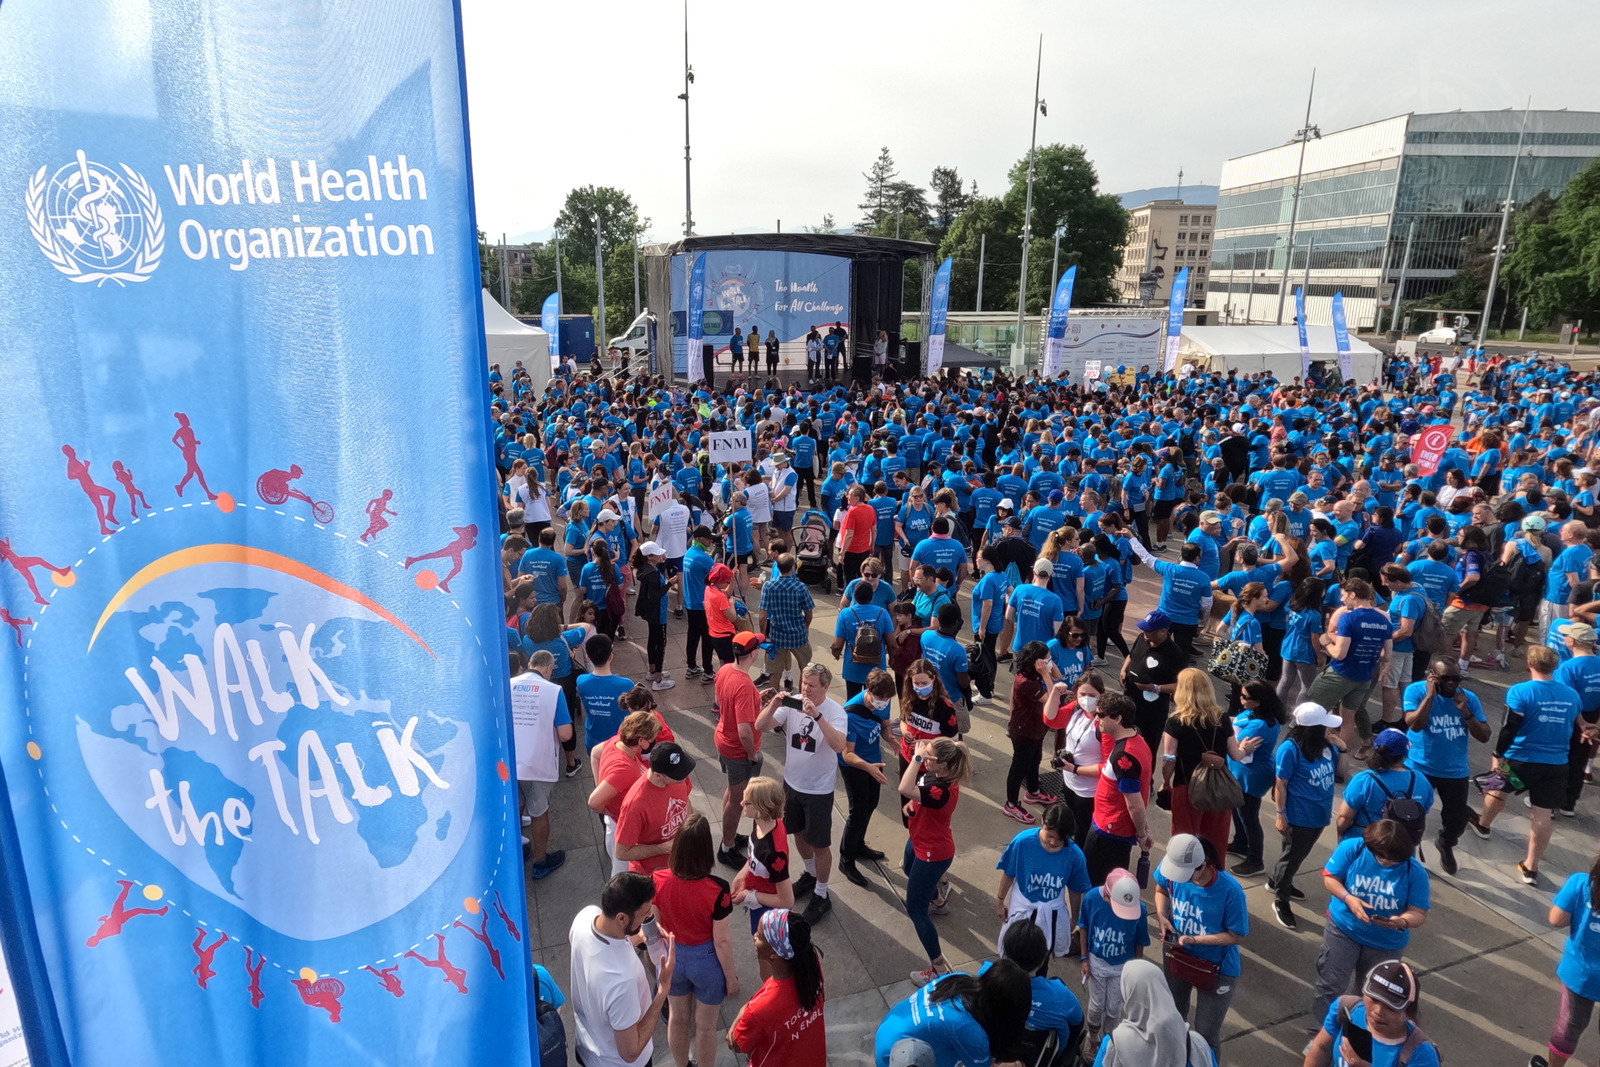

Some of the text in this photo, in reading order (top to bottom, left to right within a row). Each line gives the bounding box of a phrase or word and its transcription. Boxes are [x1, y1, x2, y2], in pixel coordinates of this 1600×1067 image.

[164, 154, 428, 206] World Health
[178, 212, 435, 271] Organization
[721, 286, 742, 299] WALK
[774, 279, 819, 294] The Health
[774, 298, 844, 316] For All Challenge
[712, 437, 748, 451] FNM
[1420, 449, 1439, 462] INFO
[650, 489, 671, 509] FNM
[123, 621, 350, 742] WALK
[512, 685, 540, 693] #ENDTB
[907, 714, 934, 732] ANADA
[1431, 714, 1462, 728] WALK
[1443, 727, 1467, 742] TALK
[1309, 761, 1334, 779] WALK
[144, 716, 451, 847] the TALK
[1320, 773, 1335, 792] TAL
[1030, 873, 1063, 889] WALK
[1354, 873, 1396, 897] WALK
[1171, 897, 1204, 922] WALK
[1367, 892, 1400, 911] TALK
[1093, 926, 1126, 945] WALK
[1176, 917, 1208, 936] TALK
[1100, 942, 1128, 958] TALK
